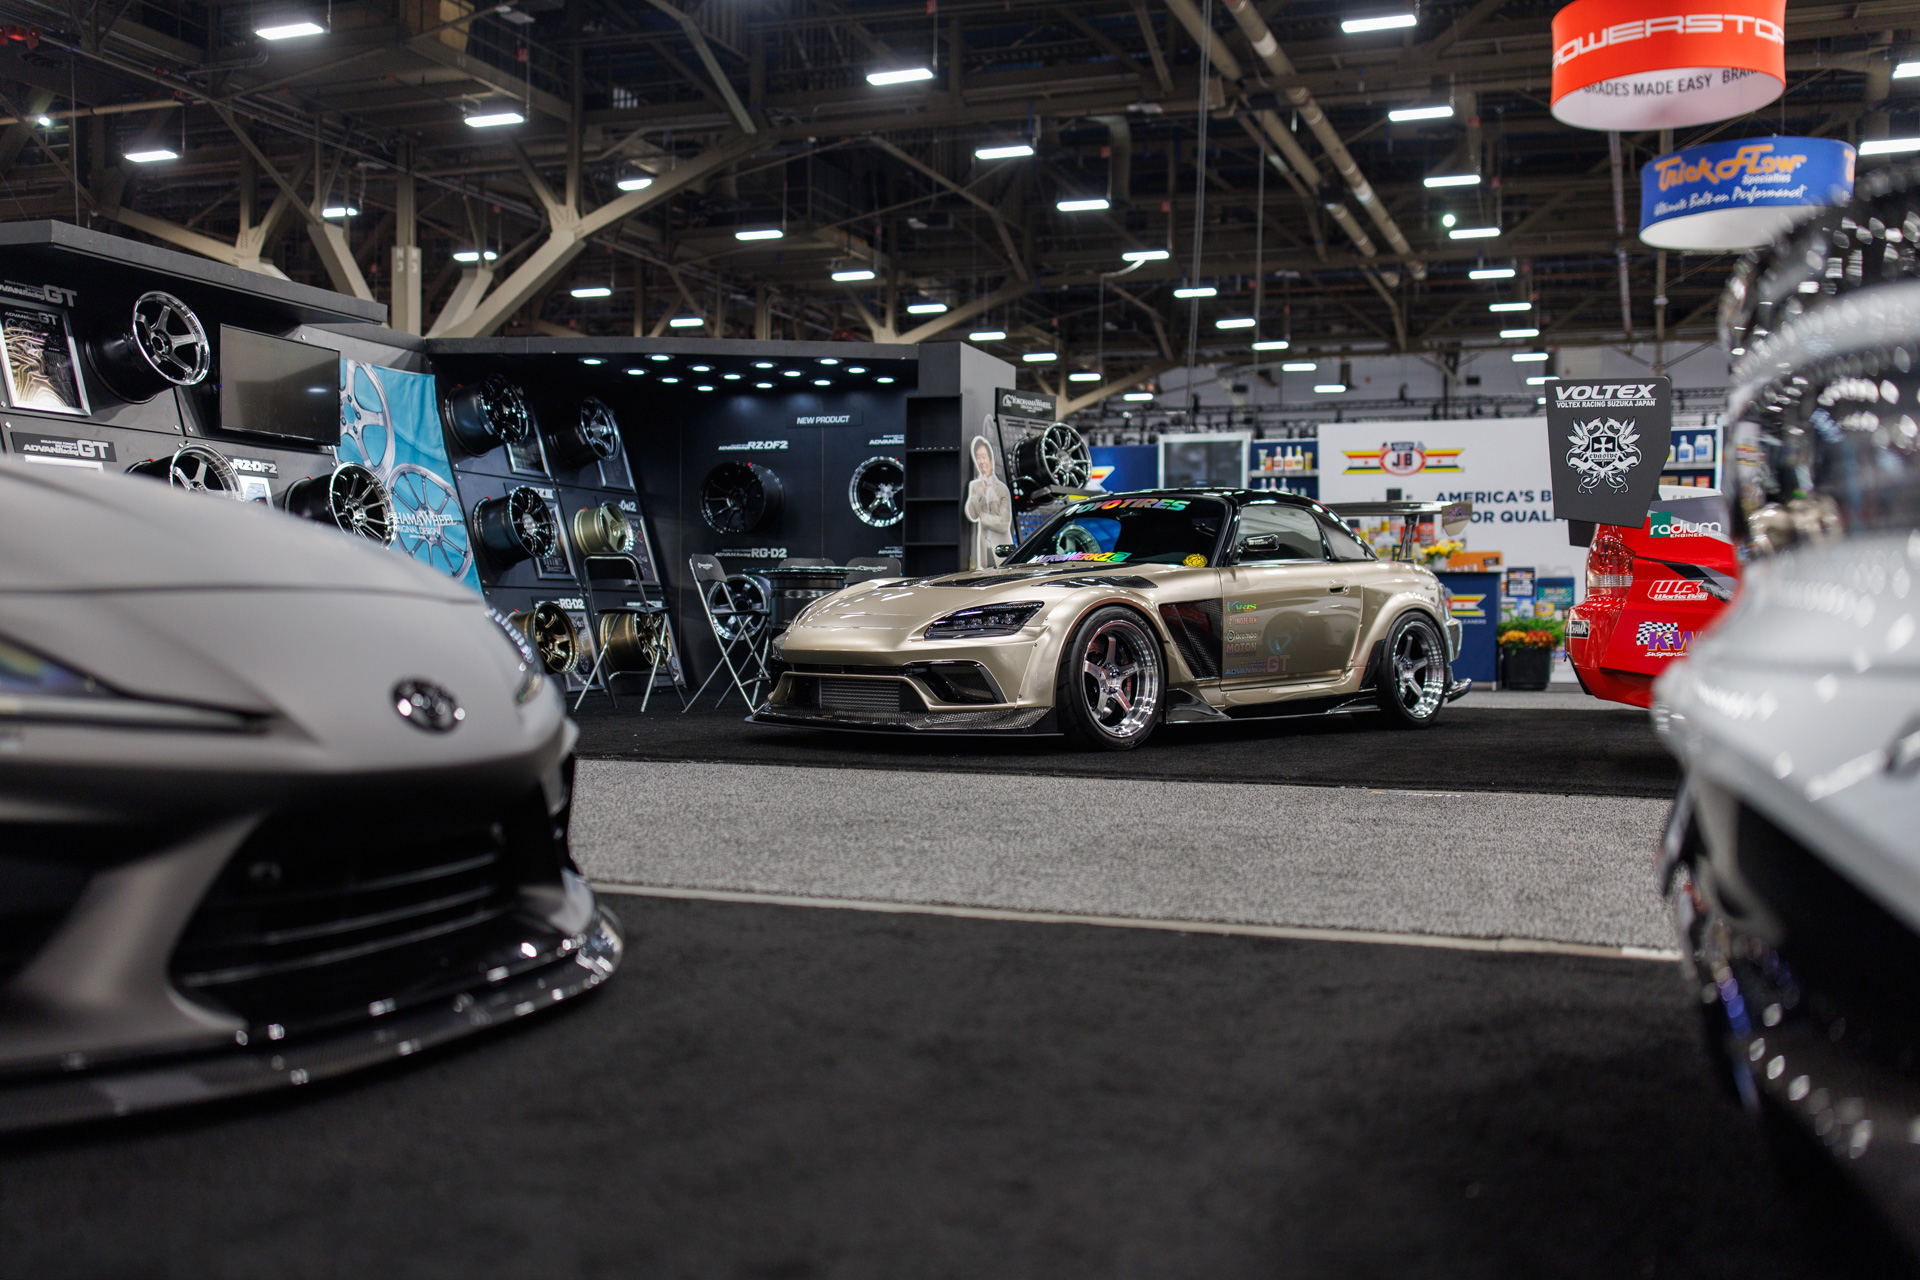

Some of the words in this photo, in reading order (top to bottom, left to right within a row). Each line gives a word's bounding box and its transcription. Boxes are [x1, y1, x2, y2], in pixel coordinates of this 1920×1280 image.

[1634, 80, 1674, 96] MADE
[1678, 73, 1713, 93] EASY
[43, 284, 78, 307] GT
[38, 312, 58, 326] GT
[1555, 384, 1657, 400] VOLTEX
[1607, 399, 1633, 407] SUZUKA
[1634, 399, 1656, 407] JAPAN
[797, 417, 814, 425] NEW
[815, 415, 850, 424] PRODUCT
[77, 440, 109, 459] GT
[1436, 489, 1535, 504] AMERICA'S
[1470, 512, 1495, 524] OR
[1650, 520, 1722, 536] radium
[1226, 642, 1257, 653] MOTON
[1647, 631, 1703, 651] KW
[1266, 654, 1291, 673] GT
